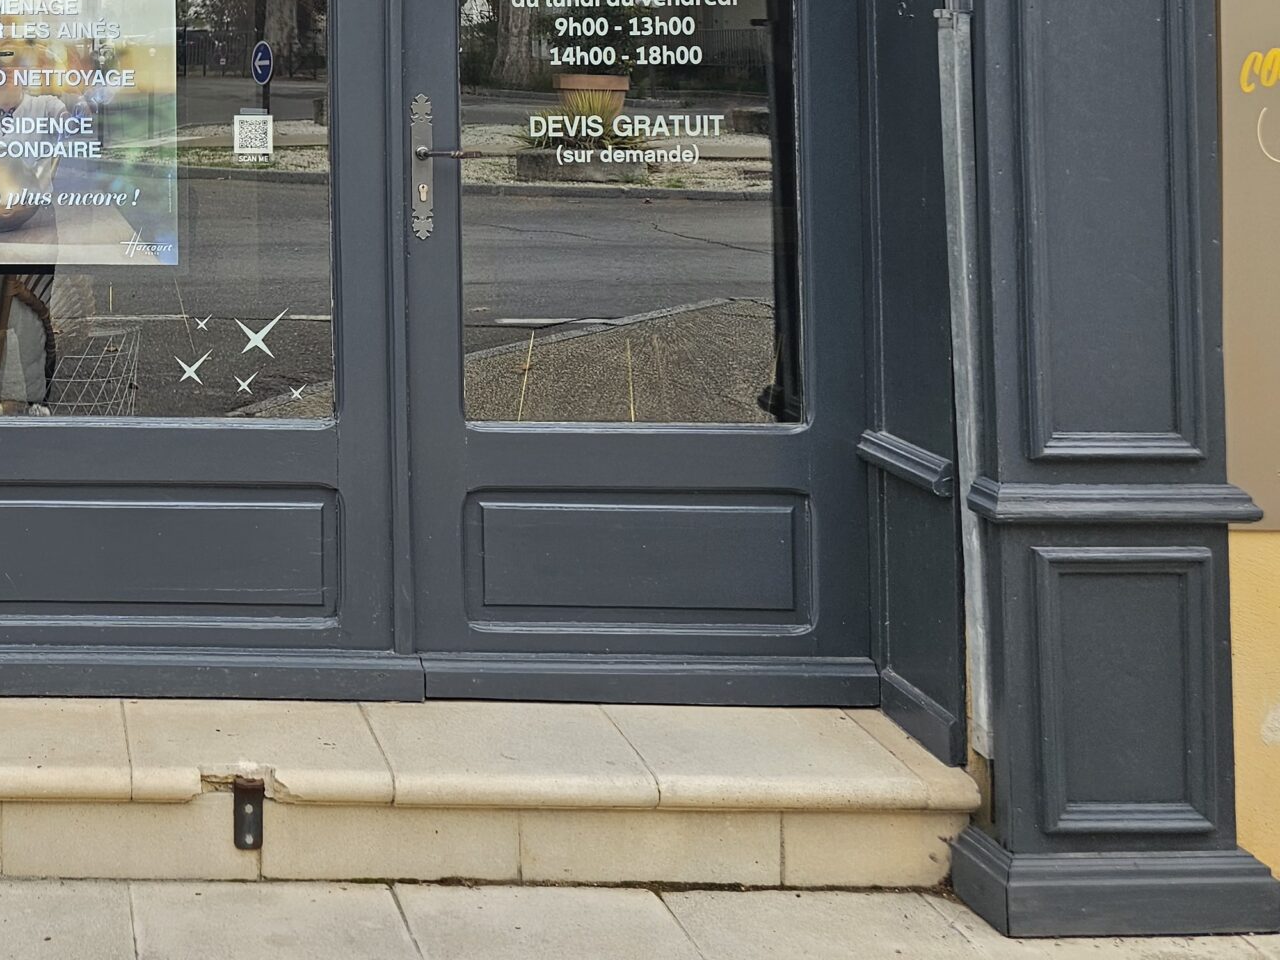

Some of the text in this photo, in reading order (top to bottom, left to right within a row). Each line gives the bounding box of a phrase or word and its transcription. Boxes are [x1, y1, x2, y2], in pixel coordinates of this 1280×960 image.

[11, 21, 50, 38] LES
[59, 17, 121, 38] AINÉS
[554, 17, 609, 36] 9h00
[629, 16, 695, 36] 13h00
[550, 46, 615, 66] 14h00
[636, 46, 702, 65] 18h00
[13, 69, 136, 86] NETTOYAGE
[529, 115, 724, 137] DEVIS GRATUIT
[238, 155, 269, 163] SCAN ME
[556, 144, 700, 166] (sur demande)
[5, 188, 52, 209] plus
[57, 192, 128, 206] encore
[131, 189, 141, 206] !
[120, 227, 173, 257] Harcourt
